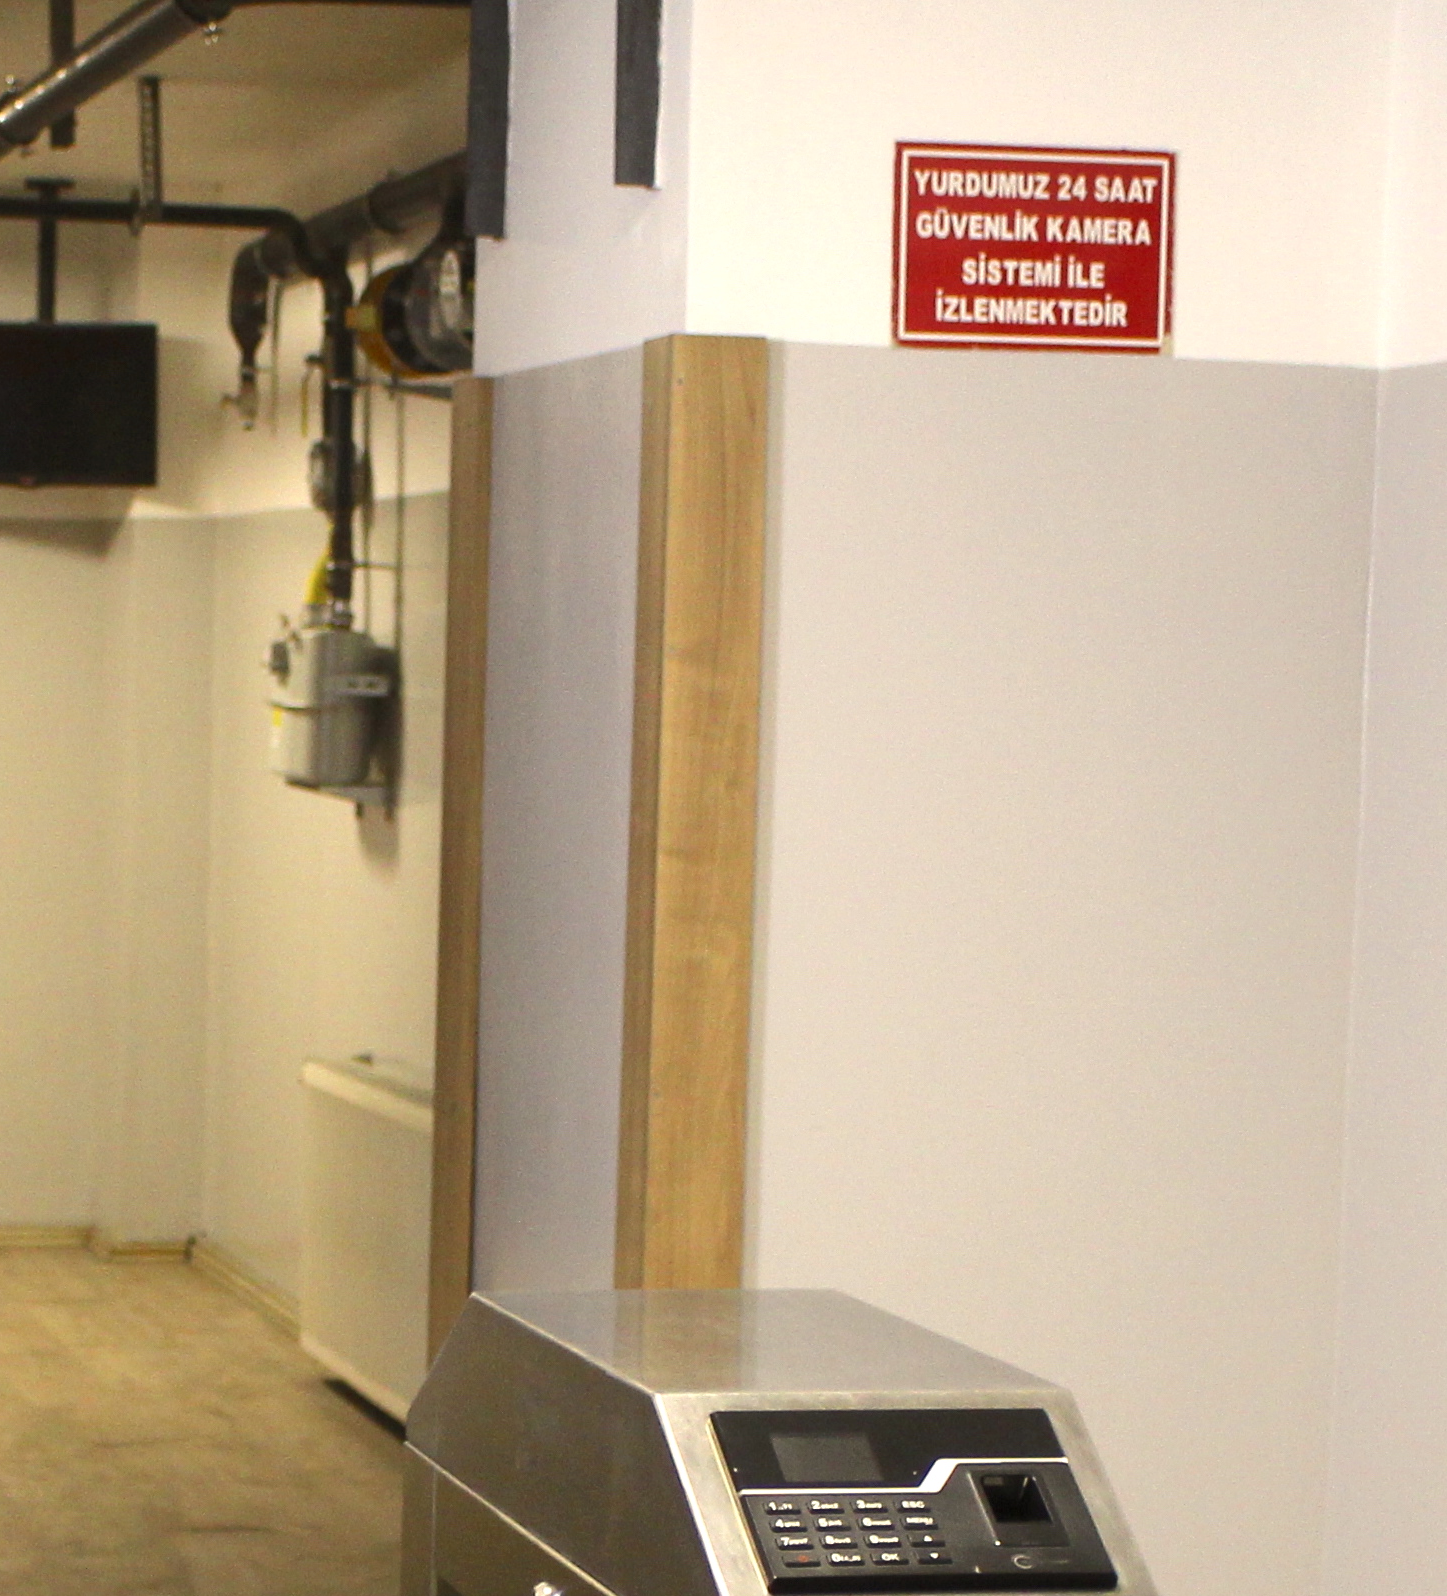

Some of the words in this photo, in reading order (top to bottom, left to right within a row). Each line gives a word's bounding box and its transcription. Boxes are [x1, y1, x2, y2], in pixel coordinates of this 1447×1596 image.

[914, 169, 1051, 200] YURDUMUZ
[1058, 176, 1087, 201] 24
[1094, 176, 1158, 204] SAAT
[915, 207, 1040, 241] GÜVENLİK
[1046, 216, 1152, 246] KAMERA
[962, 252, 1060, 288] SİSTEMİ
[1067, 255, 1105, 289] İLE
[935, 288, 1128, 328] İZLENMEKTEDİR
